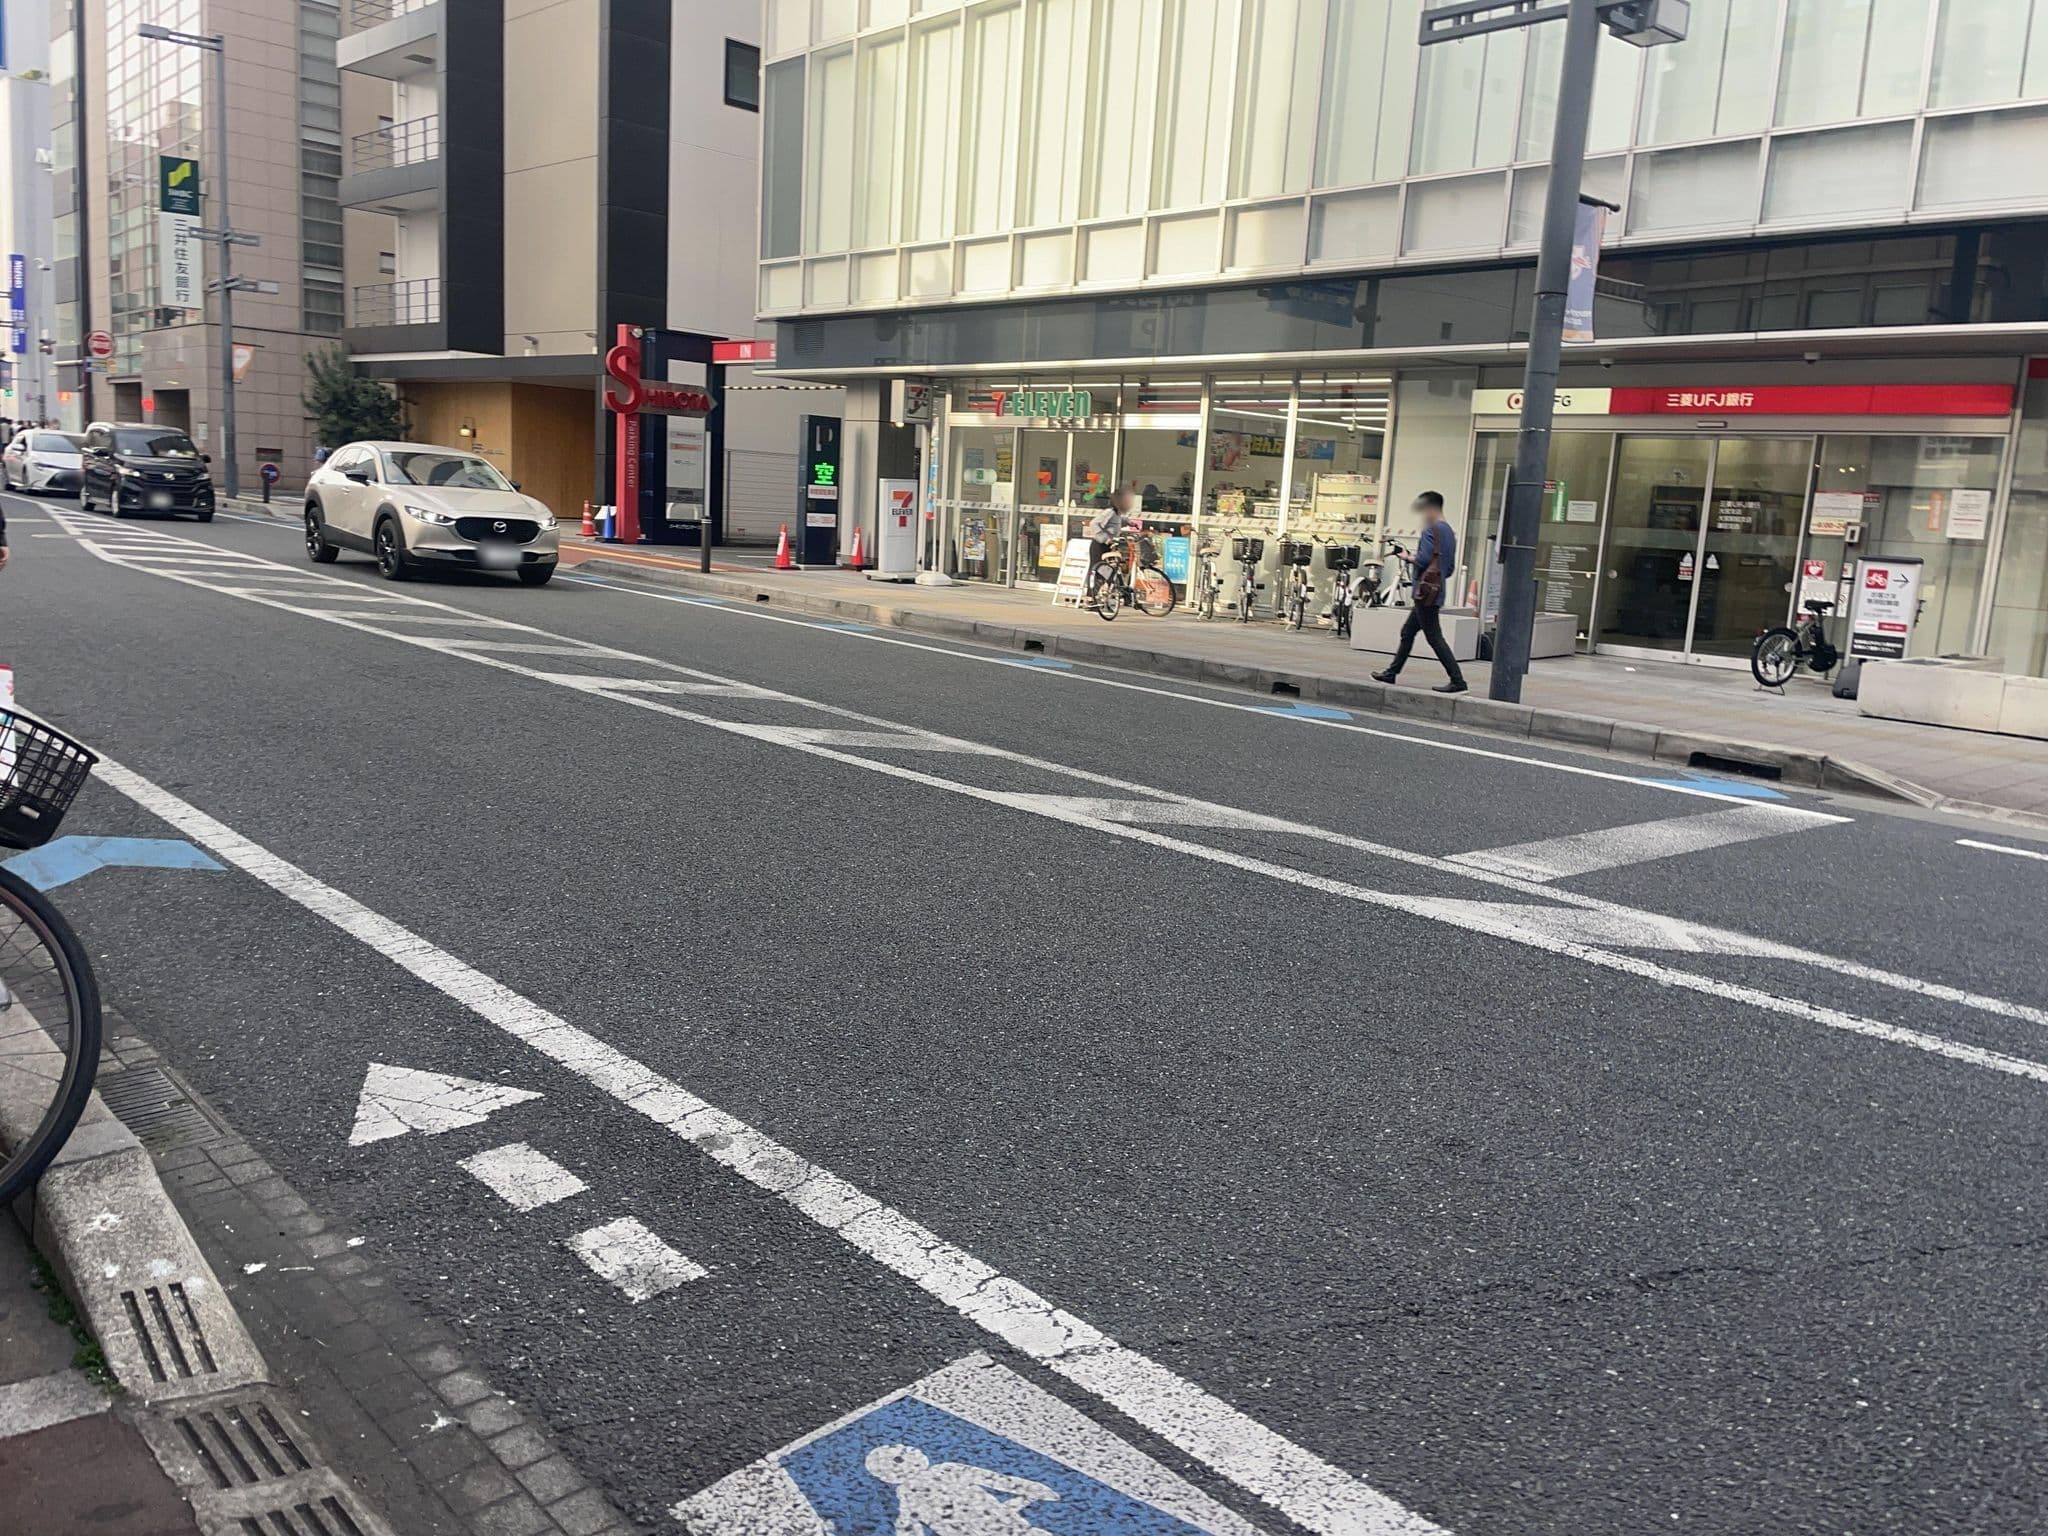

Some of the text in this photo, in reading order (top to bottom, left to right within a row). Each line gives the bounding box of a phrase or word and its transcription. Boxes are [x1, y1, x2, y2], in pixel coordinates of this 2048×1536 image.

[174, 218, 190, 302] 三井住友銀行
[1666, 393, 1754, 407] 三菱UFJ銀行
[627, 420, 638, 487] Parking Center
[814, 462, 835, 485] 空
